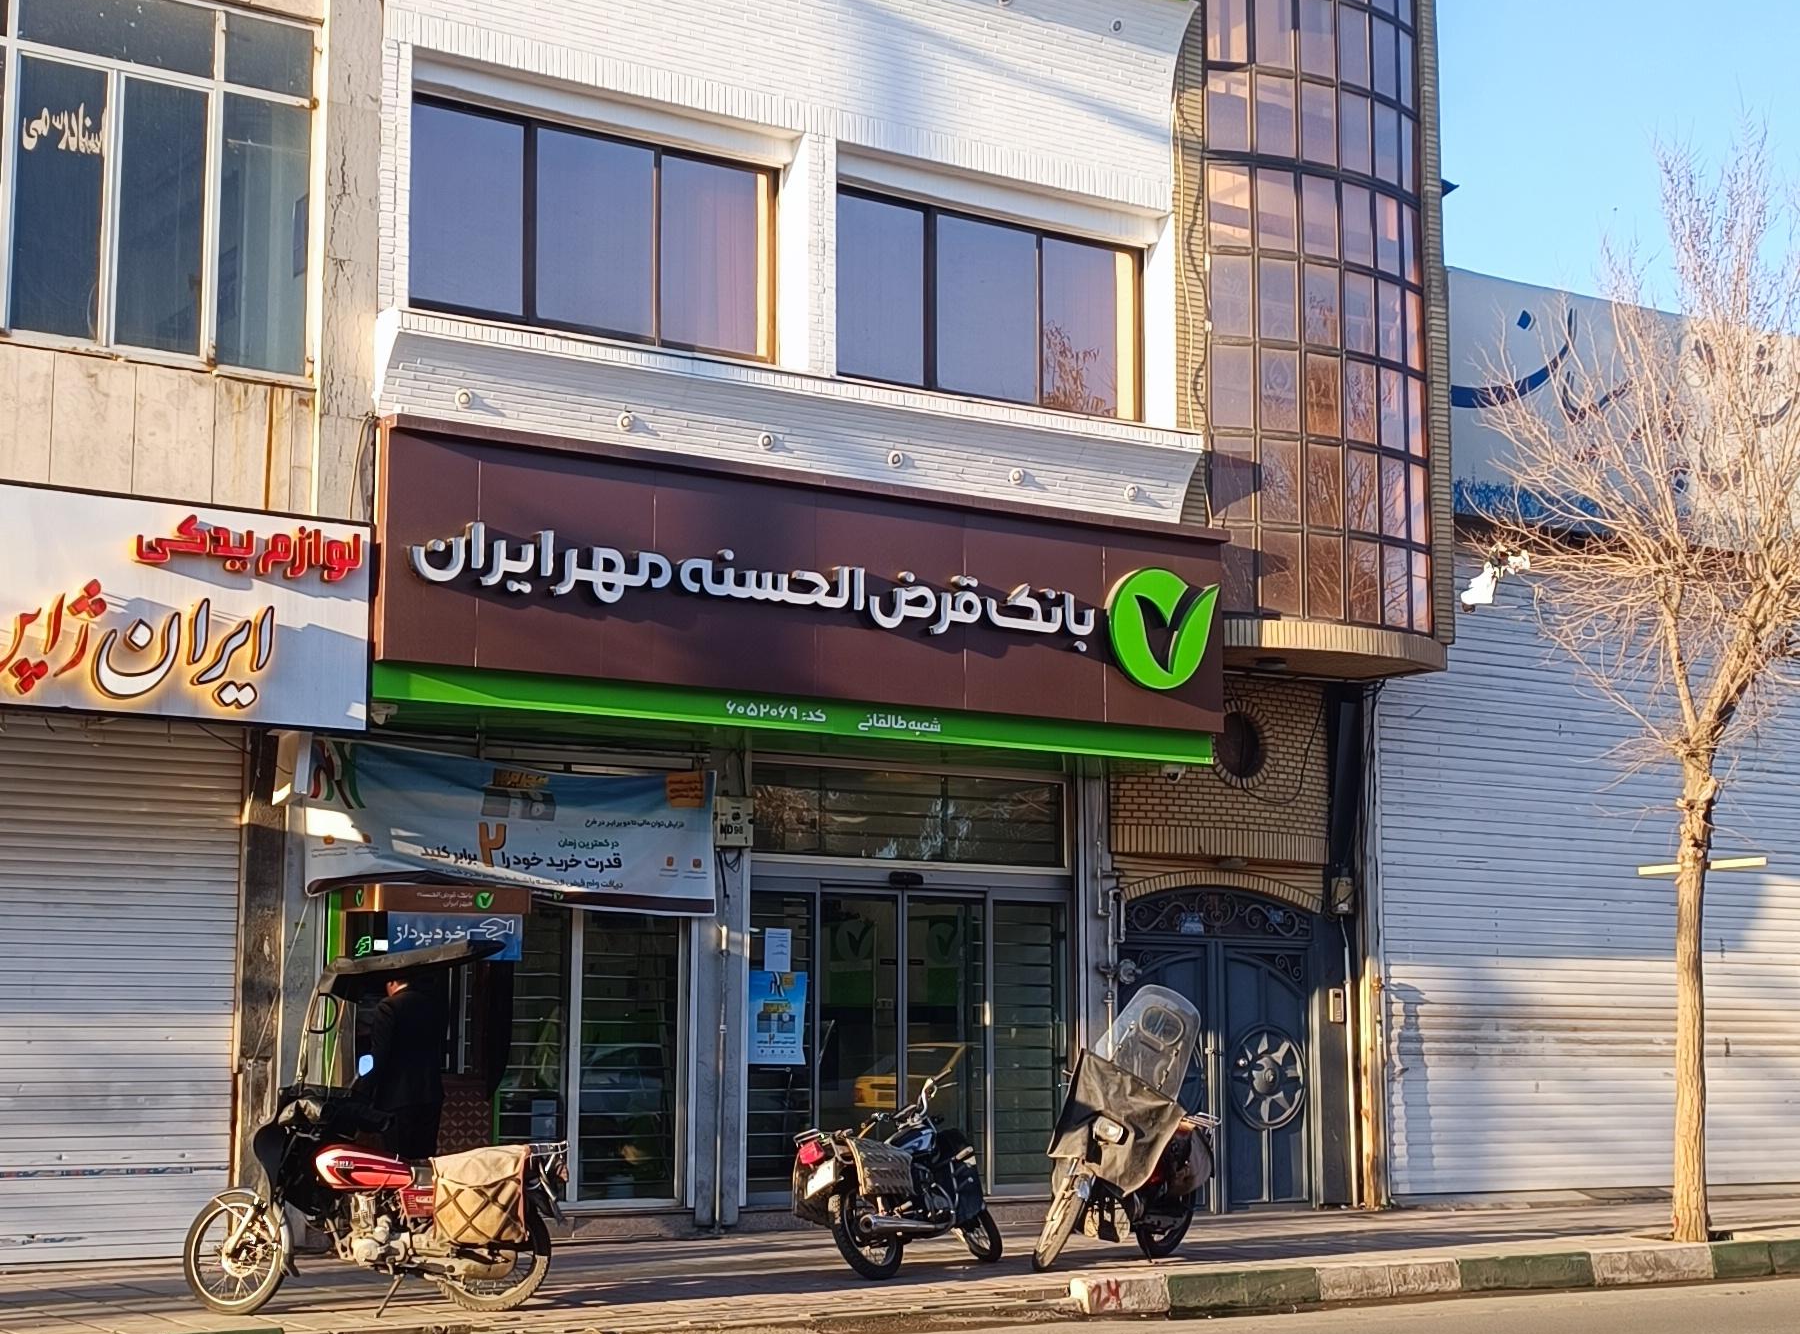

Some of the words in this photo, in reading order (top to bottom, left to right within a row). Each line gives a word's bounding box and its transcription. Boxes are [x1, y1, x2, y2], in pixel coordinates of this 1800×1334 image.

[130, 513, 255, 573] یدکی
[256, 525, 364, 584] لوازم
[406, 520, 555, 596] ایران
[550, 545, 670, 605] مهر
[679, 549, 866, 615] الحسنه
[868, 572, 982, 636] قرض
[987, 583, 1096, 653] بانک
[0, 578, 108, 695] ژاپ
[92, 597, 276, 710] ایران
[725, 699, 798, 721] ۶۰۵۲۰۶۹
[801, 708, 827, 723] کد:
[857, 712, 909, 731] طالقانی
[908, 717, 942, 737] شعبه
[420, 845, 450, 862] کنید
[478, 821, 508, 868] ۲
[557, 838, 578, 850] زمان
[578, 838, 610, 850] کمترین
[610, 840, 620, 850] در
[453, 849, 478, 866] برابر
[501, 851, 511, 869] را
[512, 852, 544, 871] خود
[545, 853, 583, 873] خرید
[584, 852, 622, 873] قدرت
